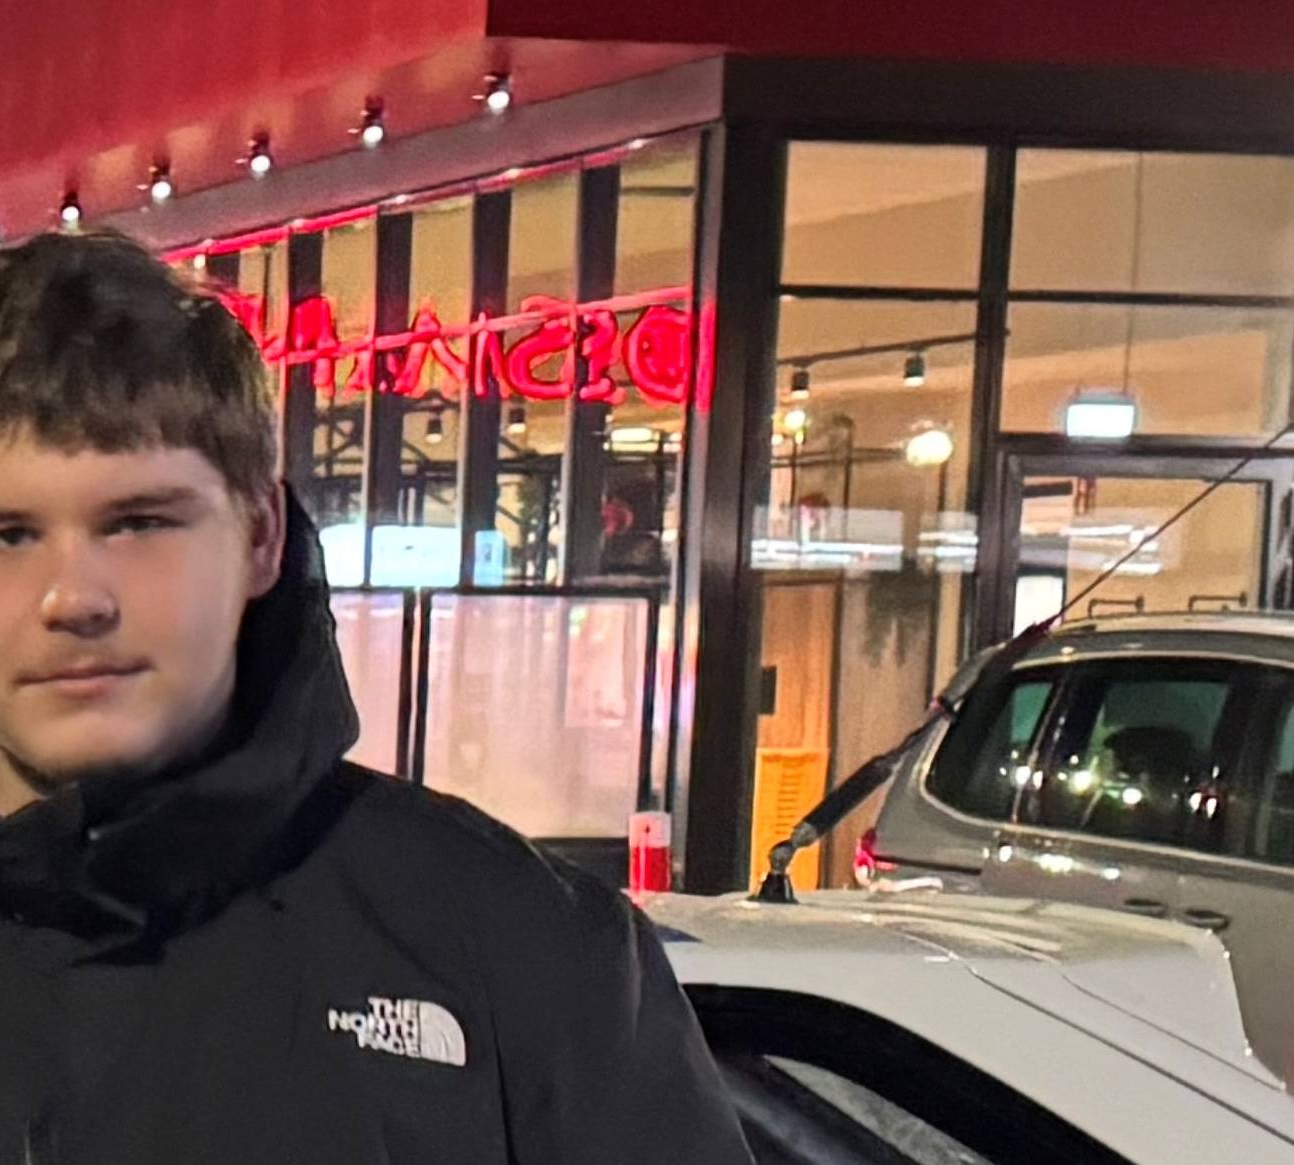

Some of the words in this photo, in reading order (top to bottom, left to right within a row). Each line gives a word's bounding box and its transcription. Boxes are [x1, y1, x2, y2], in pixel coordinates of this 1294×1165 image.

[368, 996, 419, 1020] THE
[328, 1008, 420, 1040] NORTH
[357, 1030, 420, 1058] FACE
